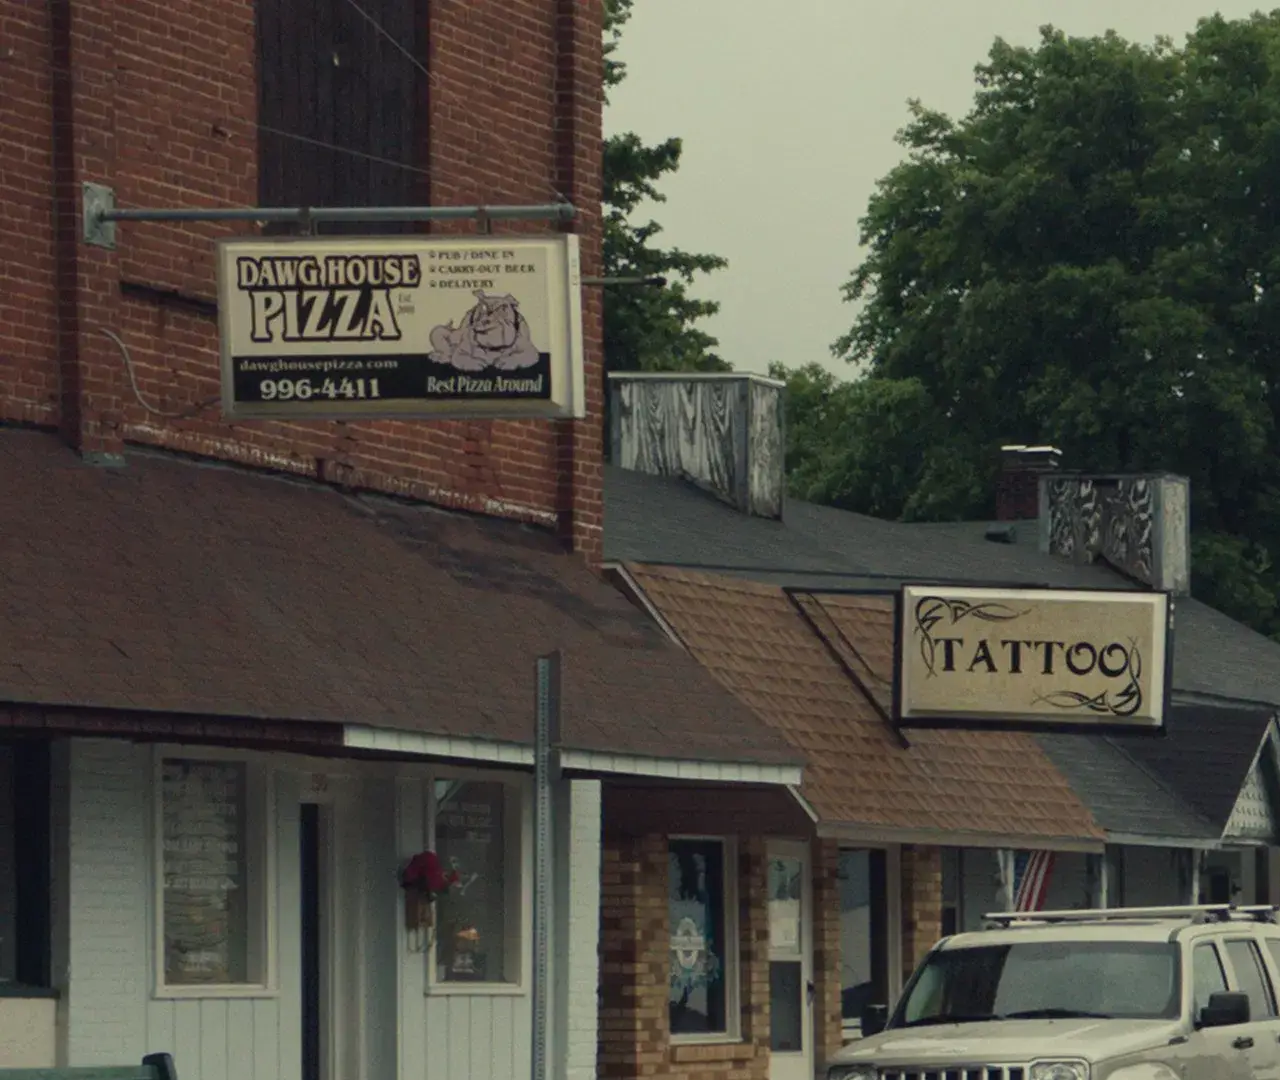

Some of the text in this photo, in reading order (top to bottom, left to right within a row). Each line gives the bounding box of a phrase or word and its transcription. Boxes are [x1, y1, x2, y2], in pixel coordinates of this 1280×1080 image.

[438, 251, 461, 260] PUB
[471, 250, 497, 260] DINE
[502, 250, 515, 259] IN
[237, 254, 421, 289] DAWG HOUSE
[438, 280, 494, 288] DELIVERY
[251, 289, 402, 342] PIZZA
[259, 377, 381, 400] 996-4411
[427, 373, 543, 393] Best Pizza Around
[933, 638, 1130, 677] TATTOO
